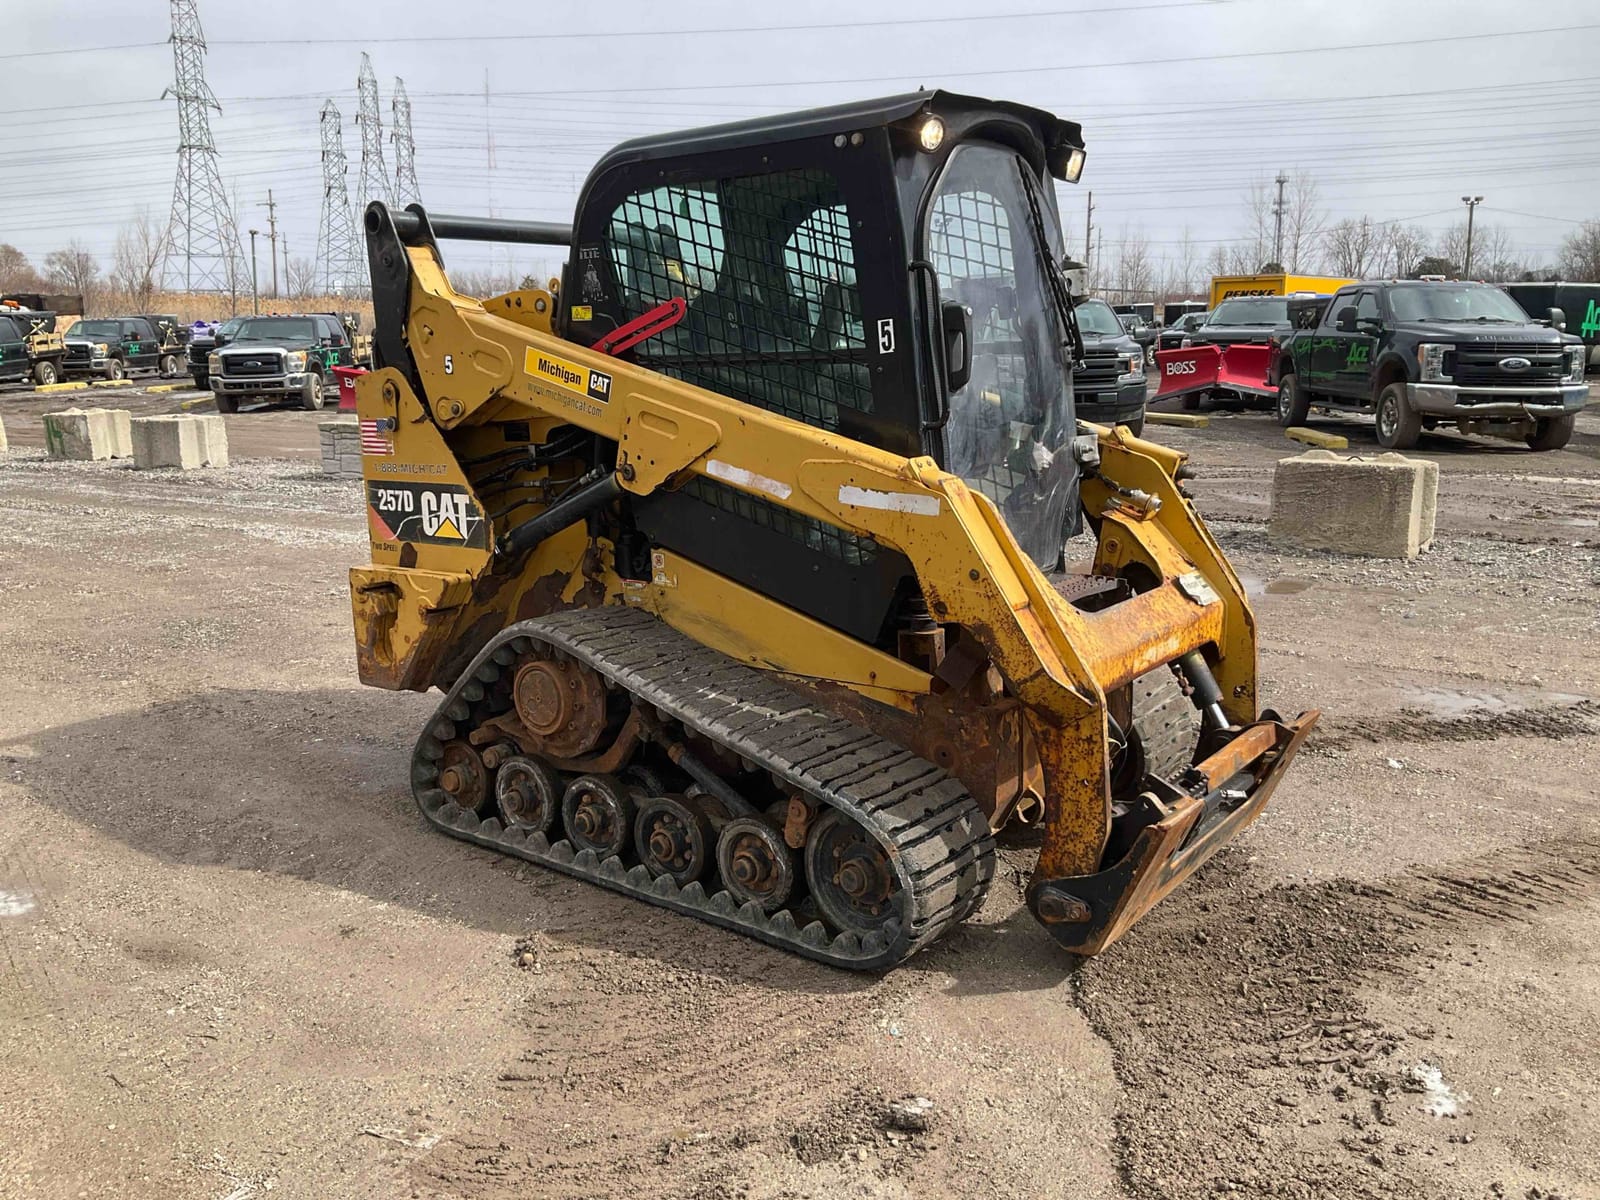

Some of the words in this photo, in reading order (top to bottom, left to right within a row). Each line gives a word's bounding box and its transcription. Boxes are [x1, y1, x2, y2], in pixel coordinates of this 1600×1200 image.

[880, 320, 893, 352] 5
[445, 355, 453, 374] 5
[538, 358, 581, 385] Michigan
[590, 374, 609, 394] CAT
[1166, 361, 1196, 375] BOSS
[378, 488, 414, 512] 257D
[421, 491, 470, 540] CAT
